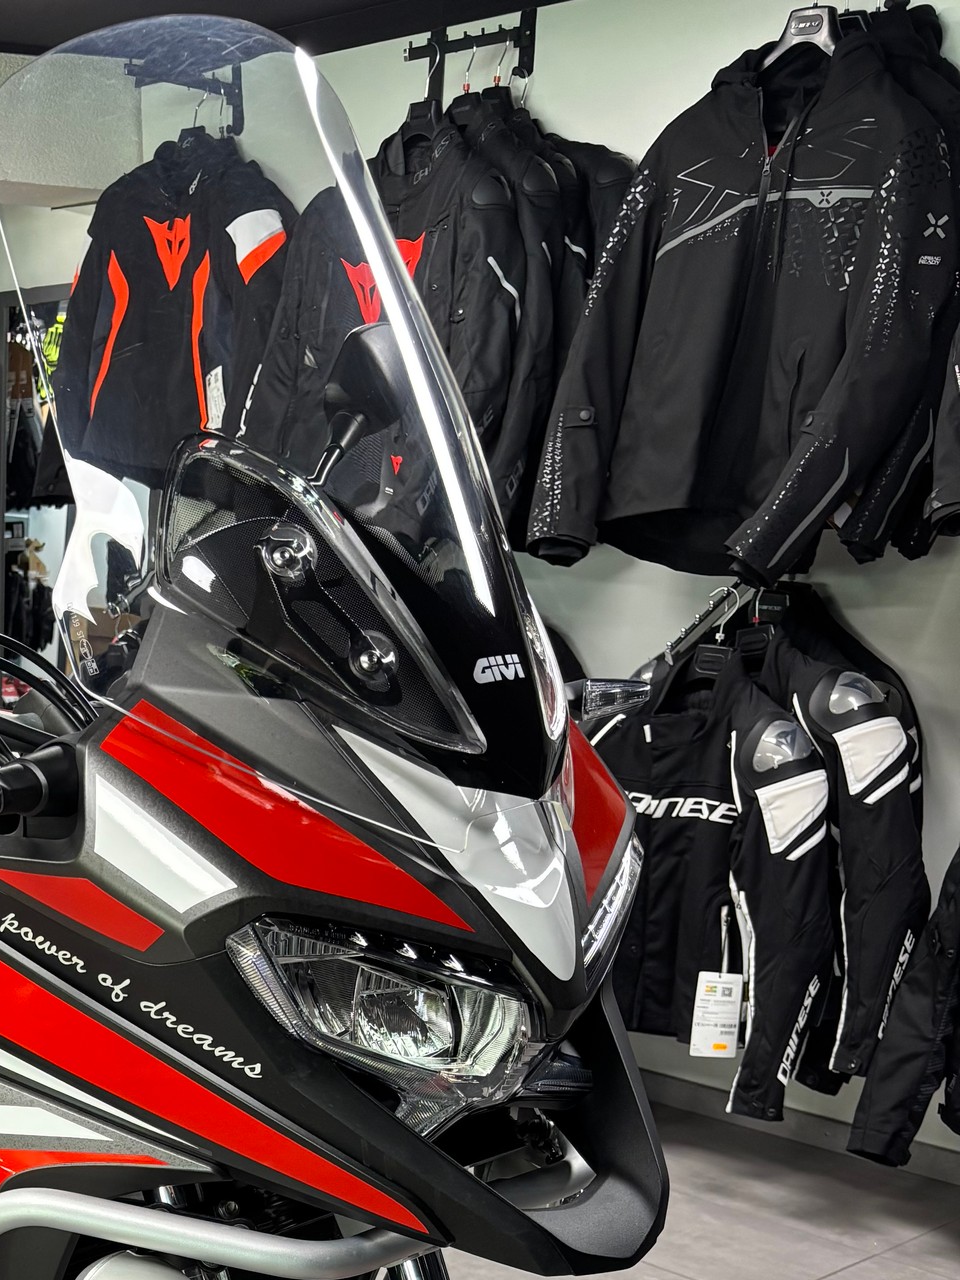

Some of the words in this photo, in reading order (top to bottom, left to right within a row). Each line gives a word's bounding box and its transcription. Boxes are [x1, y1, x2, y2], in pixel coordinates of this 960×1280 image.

[473, 654, 525, 684] GIVI
[626, 791, 738, 824] AINESE
[0, 912, 87, 974] power
[97, 973, 131, 1002] of
[140, 1000, 262, 1079] dreams
[777, 975, 821, 1087] DAINESE
